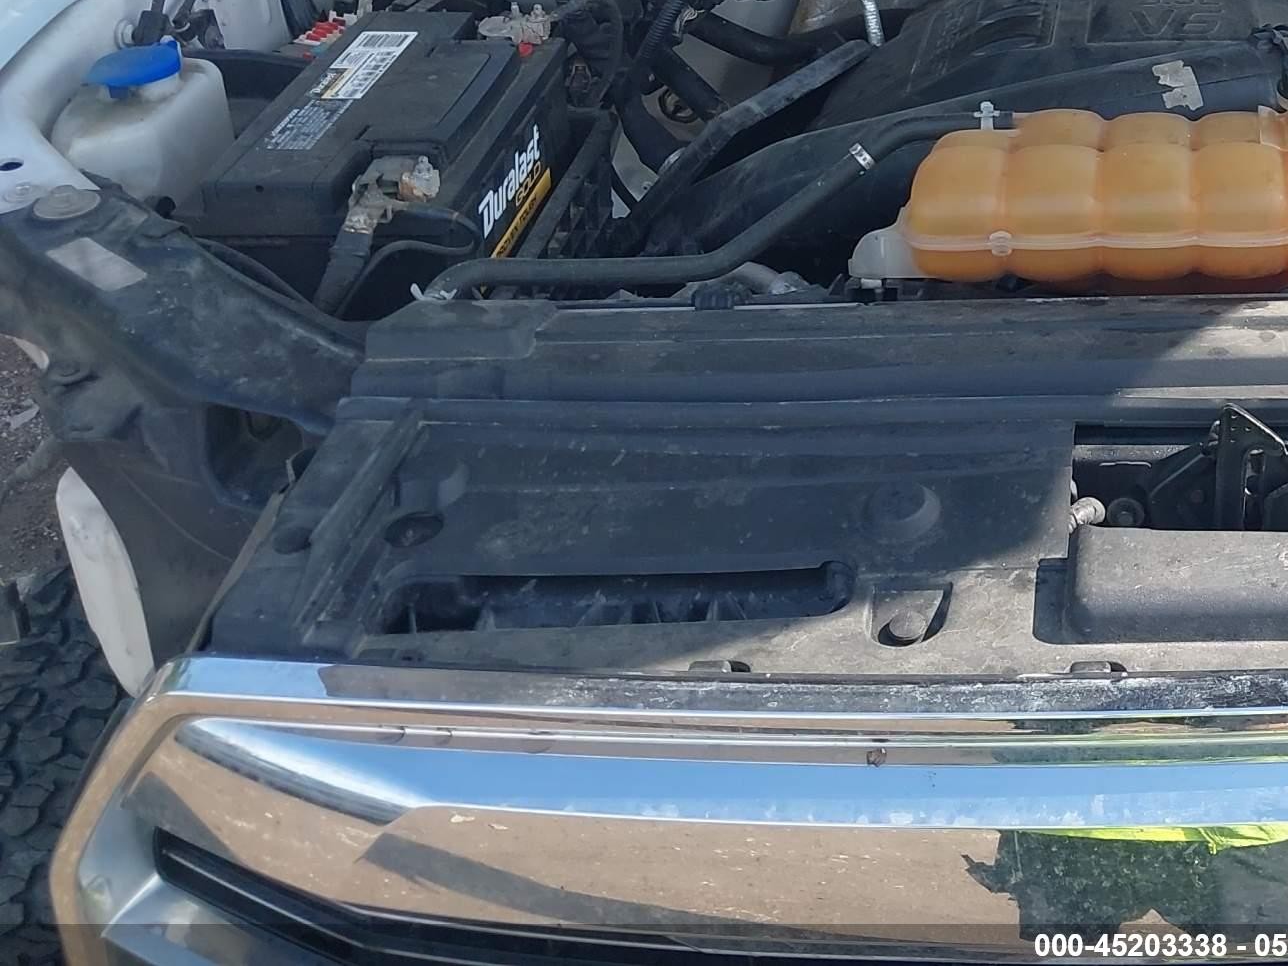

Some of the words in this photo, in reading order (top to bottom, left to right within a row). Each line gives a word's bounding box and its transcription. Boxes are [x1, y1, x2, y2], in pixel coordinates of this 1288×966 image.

[1129, 8, 1225, 36] V6
[478, 124, 541, 240] Duralast
[515, 160, 542, 207] GOLD
